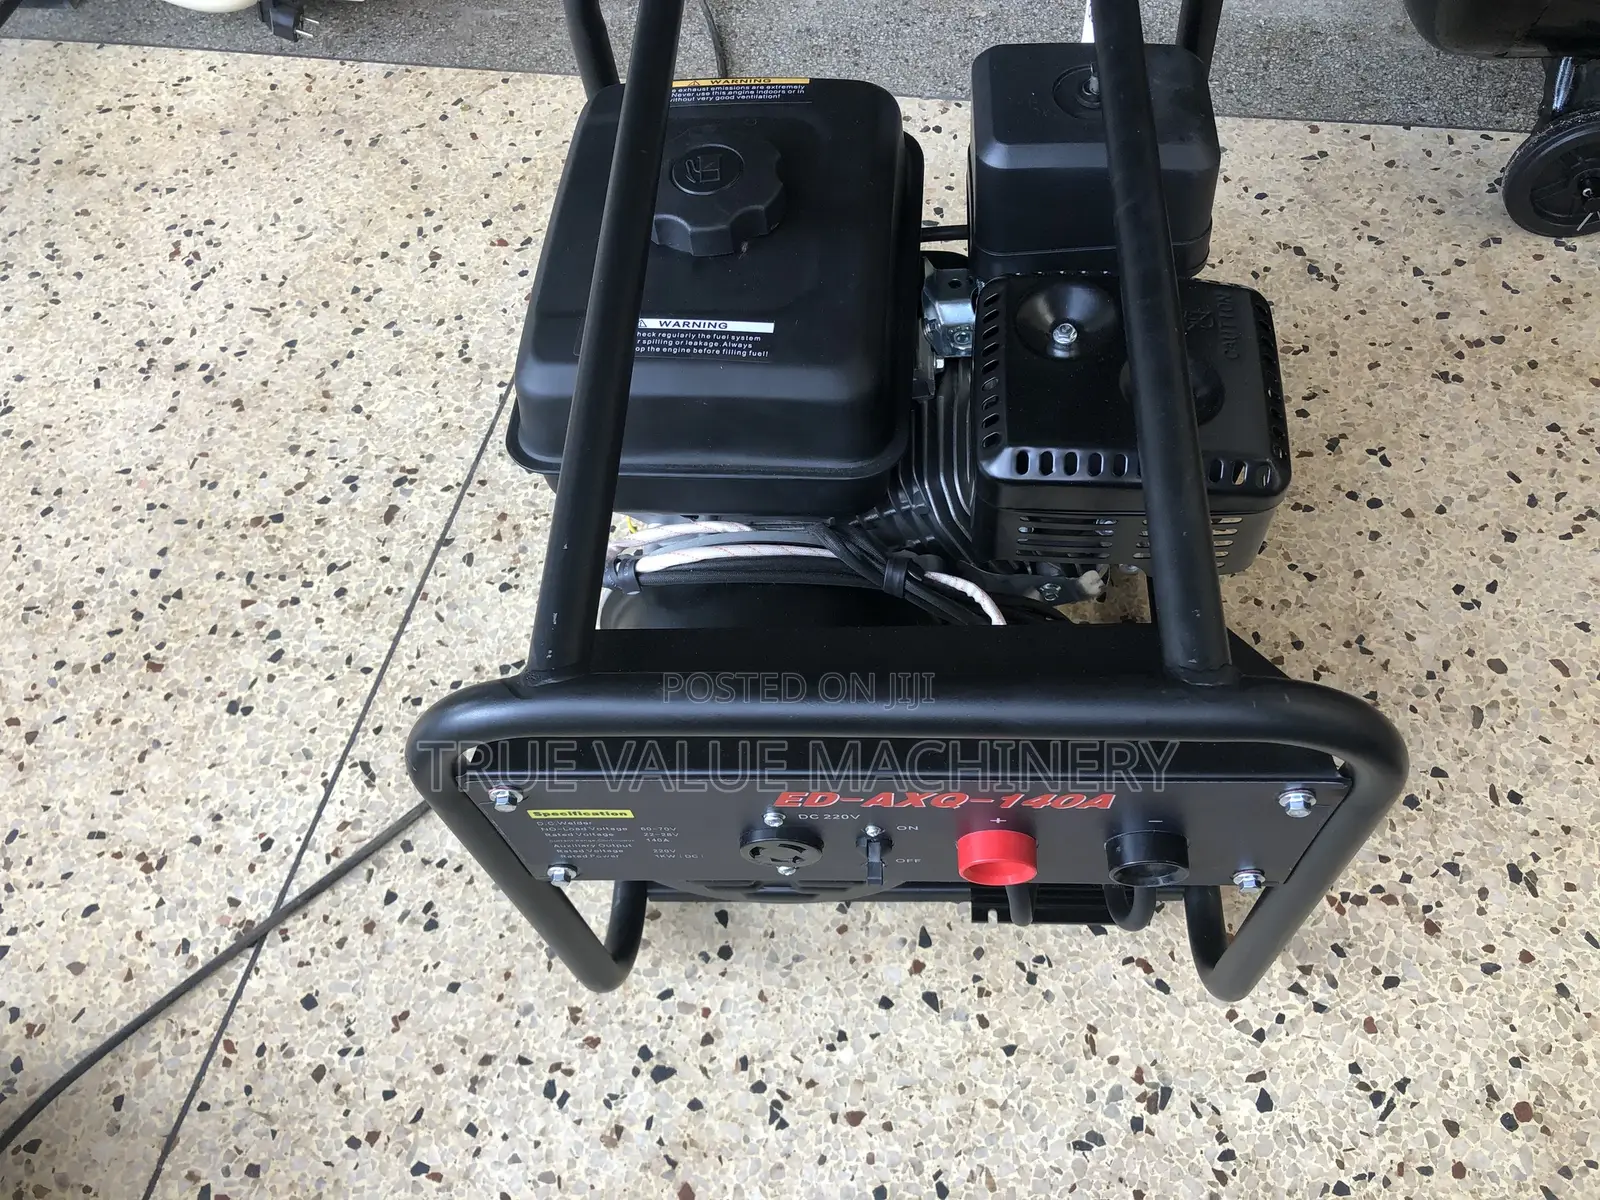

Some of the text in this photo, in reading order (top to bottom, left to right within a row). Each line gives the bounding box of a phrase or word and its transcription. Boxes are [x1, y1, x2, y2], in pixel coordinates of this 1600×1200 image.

[659, 320, 728, 329] WARNING
[1214, 289, 1240, 360] CAUTION
[722, 348, 747, 357] filling
[774, 792, 1116, 810] ED-AXQ-140A
